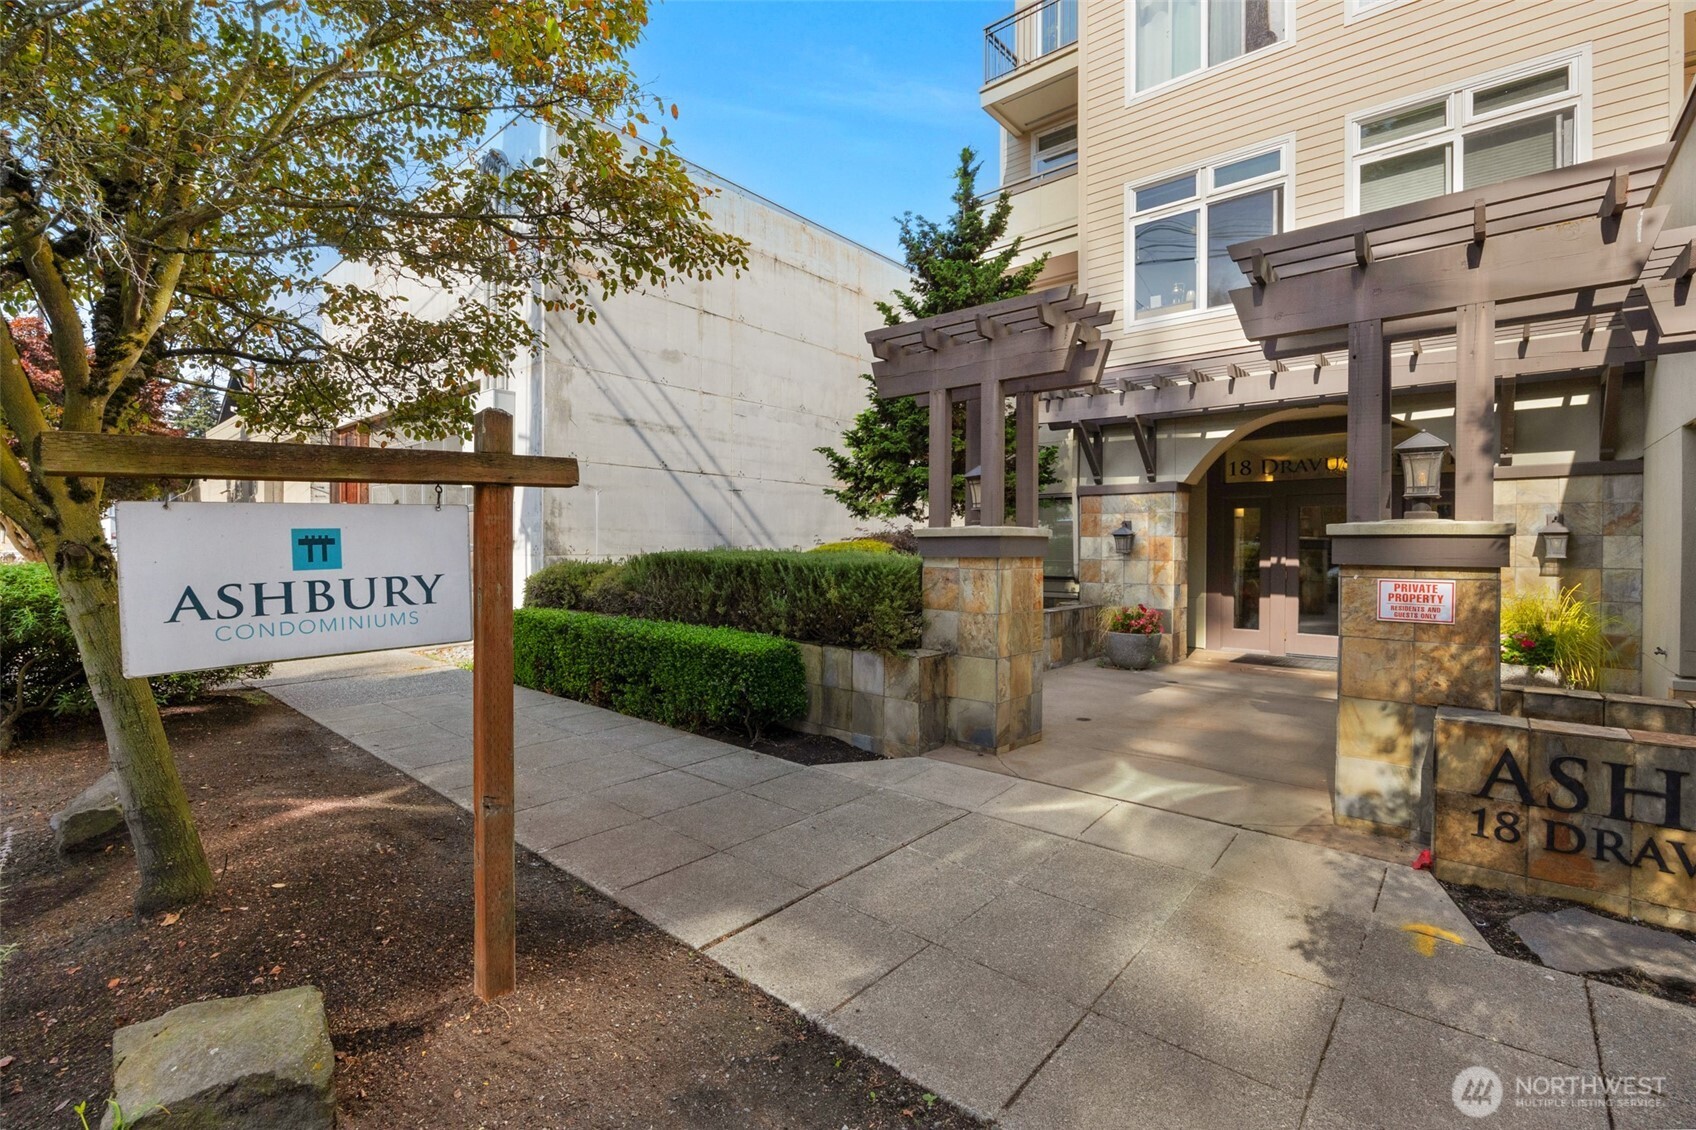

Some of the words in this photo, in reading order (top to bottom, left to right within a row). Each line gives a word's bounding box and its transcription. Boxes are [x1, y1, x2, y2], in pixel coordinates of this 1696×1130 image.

[1229, 459, 1252, 477] 18
[1393, 583, 1439, 594] PRIVATE
[163, 573, 445, 624] ASHBURY
[1387, 593, 1444, 605] PROPERTY
[1390, 605, 1425, 613] RESIDENTS
[1393, 611, 1418, 619] GUESTS
[1420, 612, 1437, 620] ONLY
[215, 610, 420, 642] CONDOMINIUMS
[1472, 747, 1696, 831] ASH
[1471, 807, 1522, 844] 18
